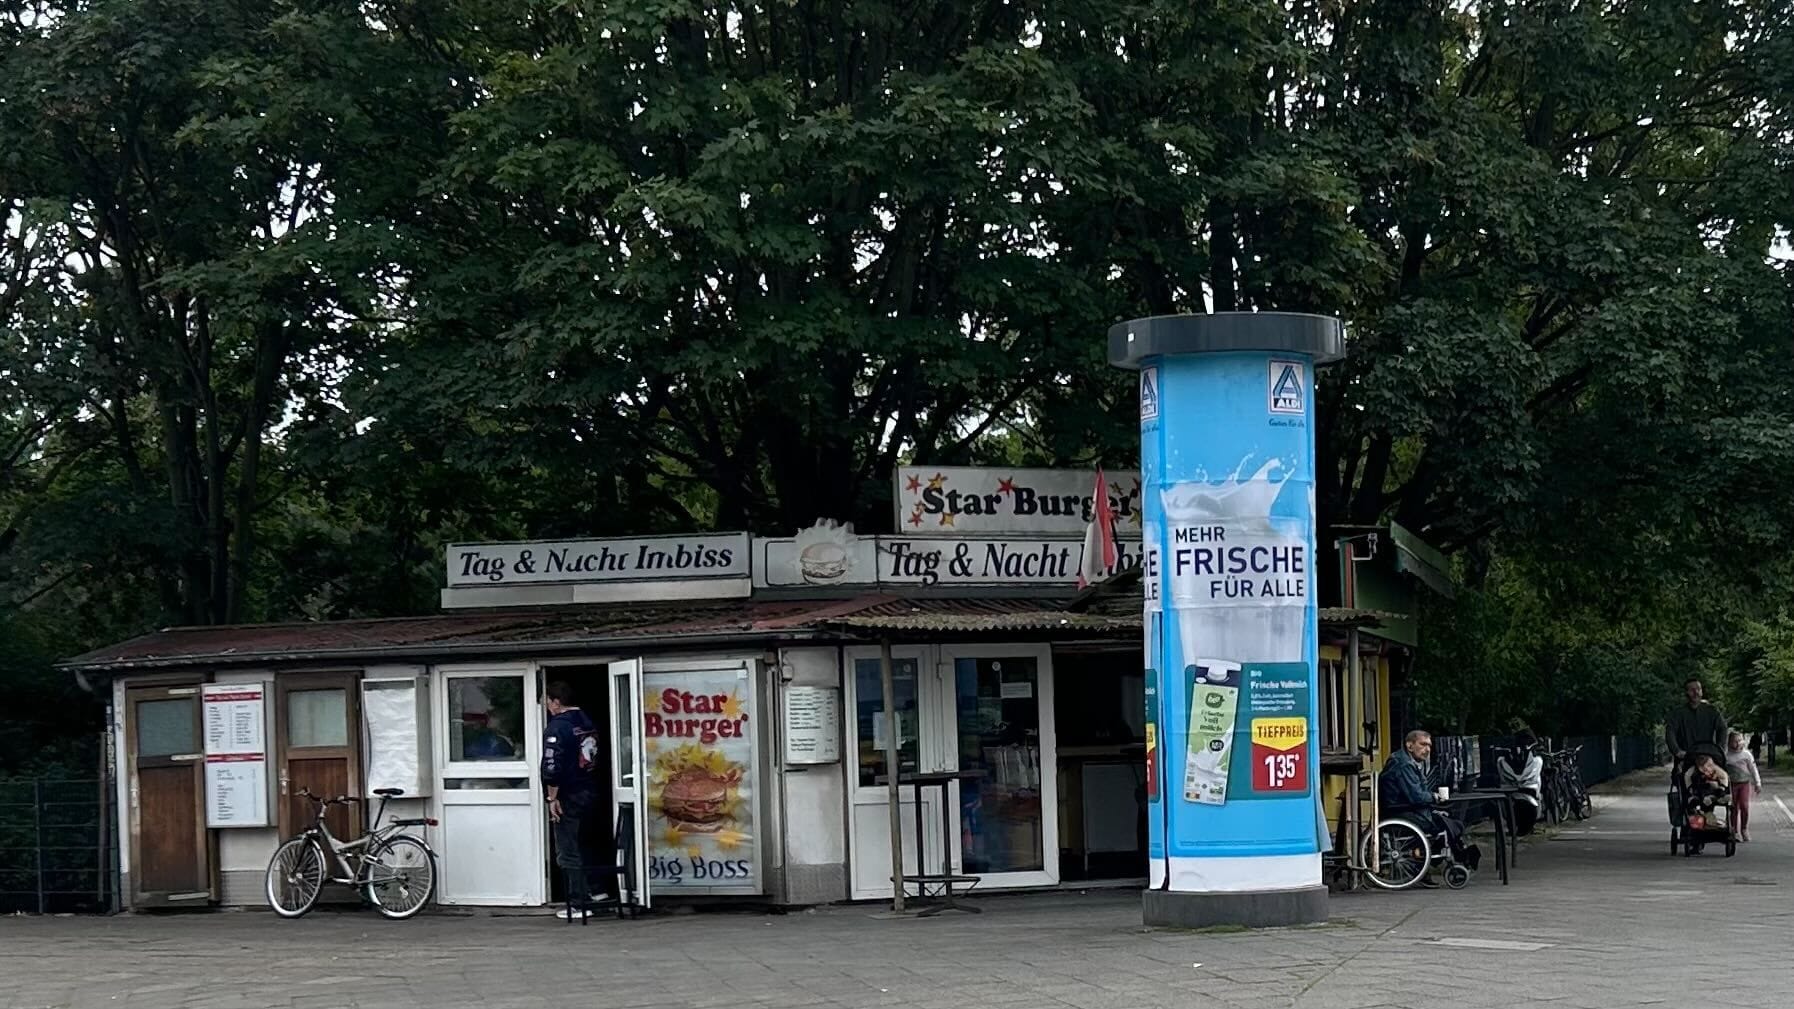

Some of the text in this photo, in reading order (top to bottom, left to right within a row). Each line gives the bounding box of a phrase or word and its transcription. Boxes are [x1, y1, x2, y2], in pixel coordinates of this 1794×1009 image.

[1276, 398, 1300, 408] ALDI
[922, 487, 1002, 515] Star
[1175, 526, 1225, 543] MEHR
[459, 552, 505, 581] Tag
[513, 549, 536, 574] &
[636, 544, 733, 570] Imbiss
[889, 542, 942, 586] Tag
[949, 542, 973, 577] &
[982, 543, 1073, 577] Nacht
[1176, 546, 1304, 576] FRISCHE
[1210, 575, 1304, 599] FÜR ALLE
[662, 688, 728, 714] Star
[644, 712, 749, 744] Burger
[1257, 725, 1304, 739] TIEFPREIS
[649, 855, 683, 884] Big
